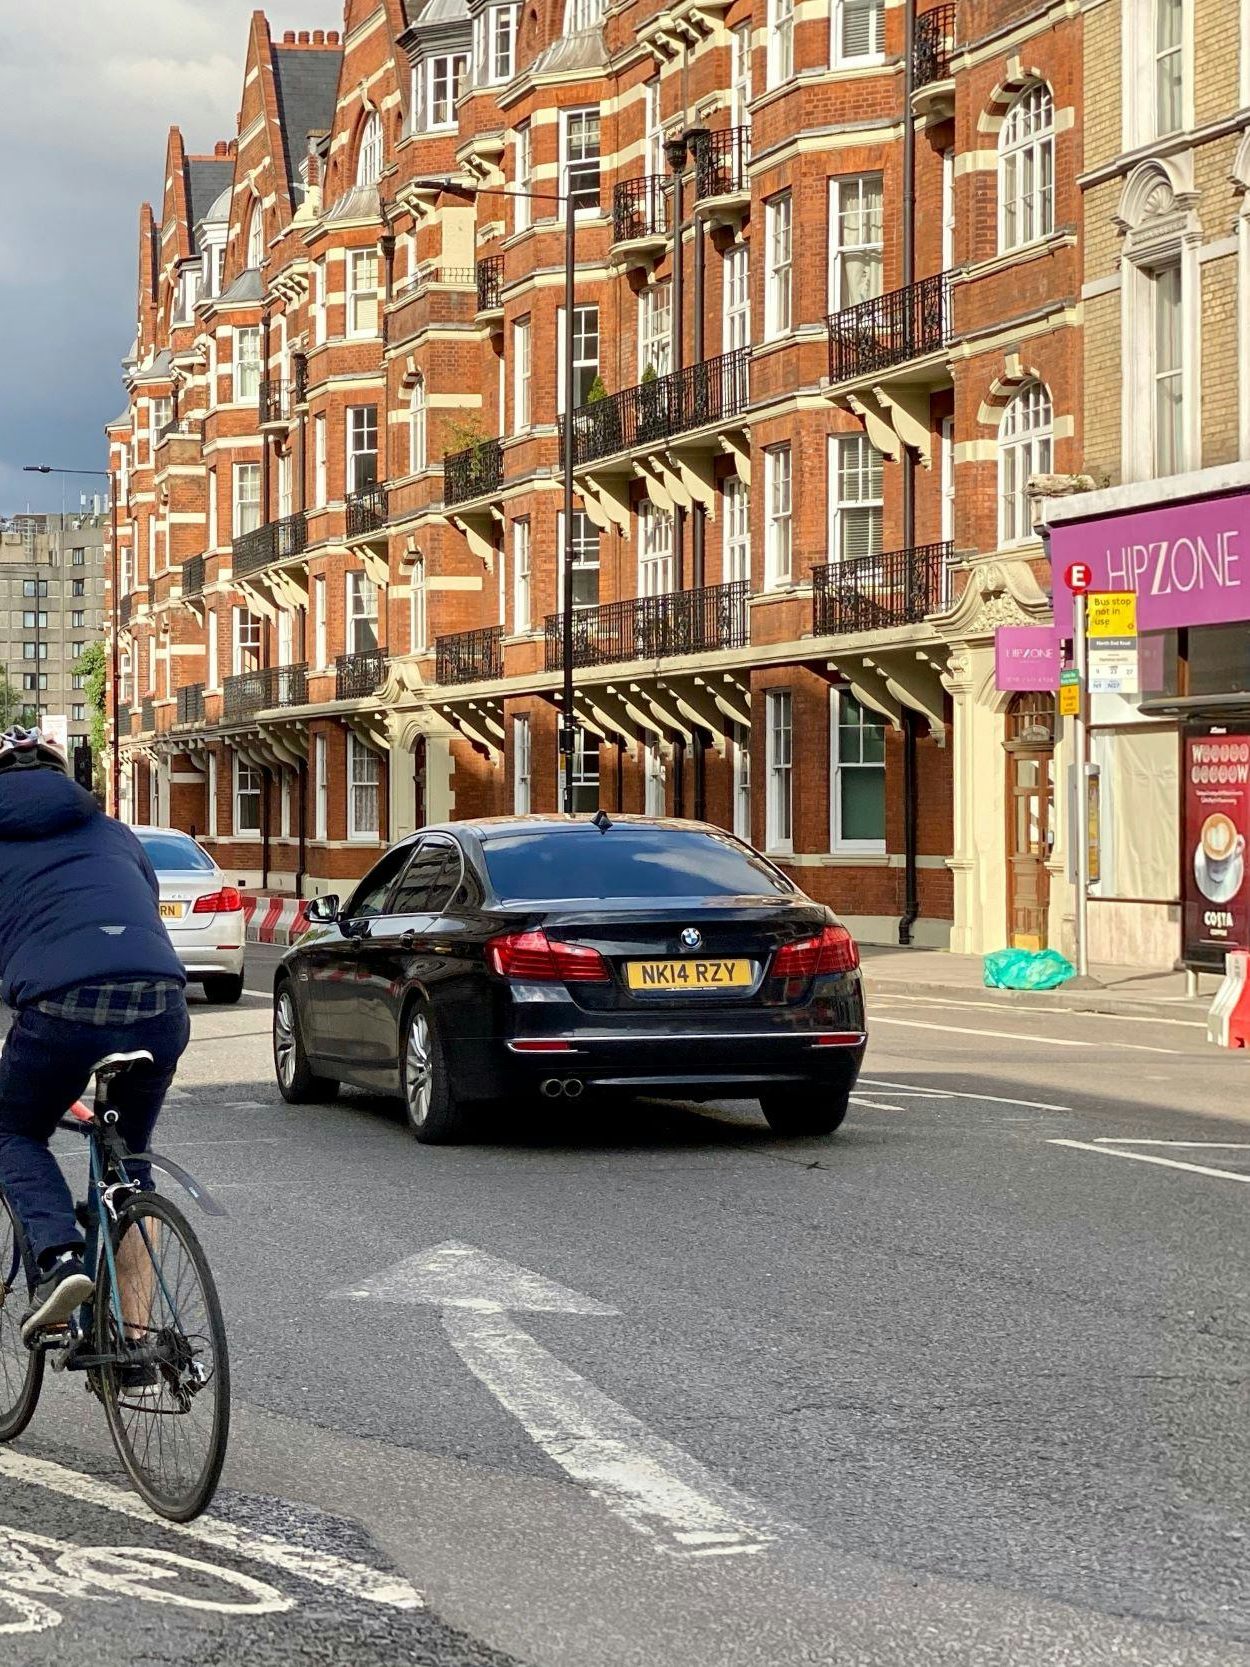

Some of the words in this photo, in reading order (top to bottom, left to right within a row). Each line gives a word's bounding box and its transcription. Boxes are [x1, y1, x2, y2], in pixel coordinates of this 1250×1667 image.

[1106, 531, 1241, 597] HIPZONE
[1071, 565, 1086, 587] E
[1094, 598, 1110, 606] Bus
[1111, 597, 1132, 607] stop
[1112, 607, 1120, 615] in
[160, 905, 176, 916] RN
[1204, 911, 1234, 928] COSTA
[642, 963, 690, 984] NK14
[695, 962, 736, 982] RZY
